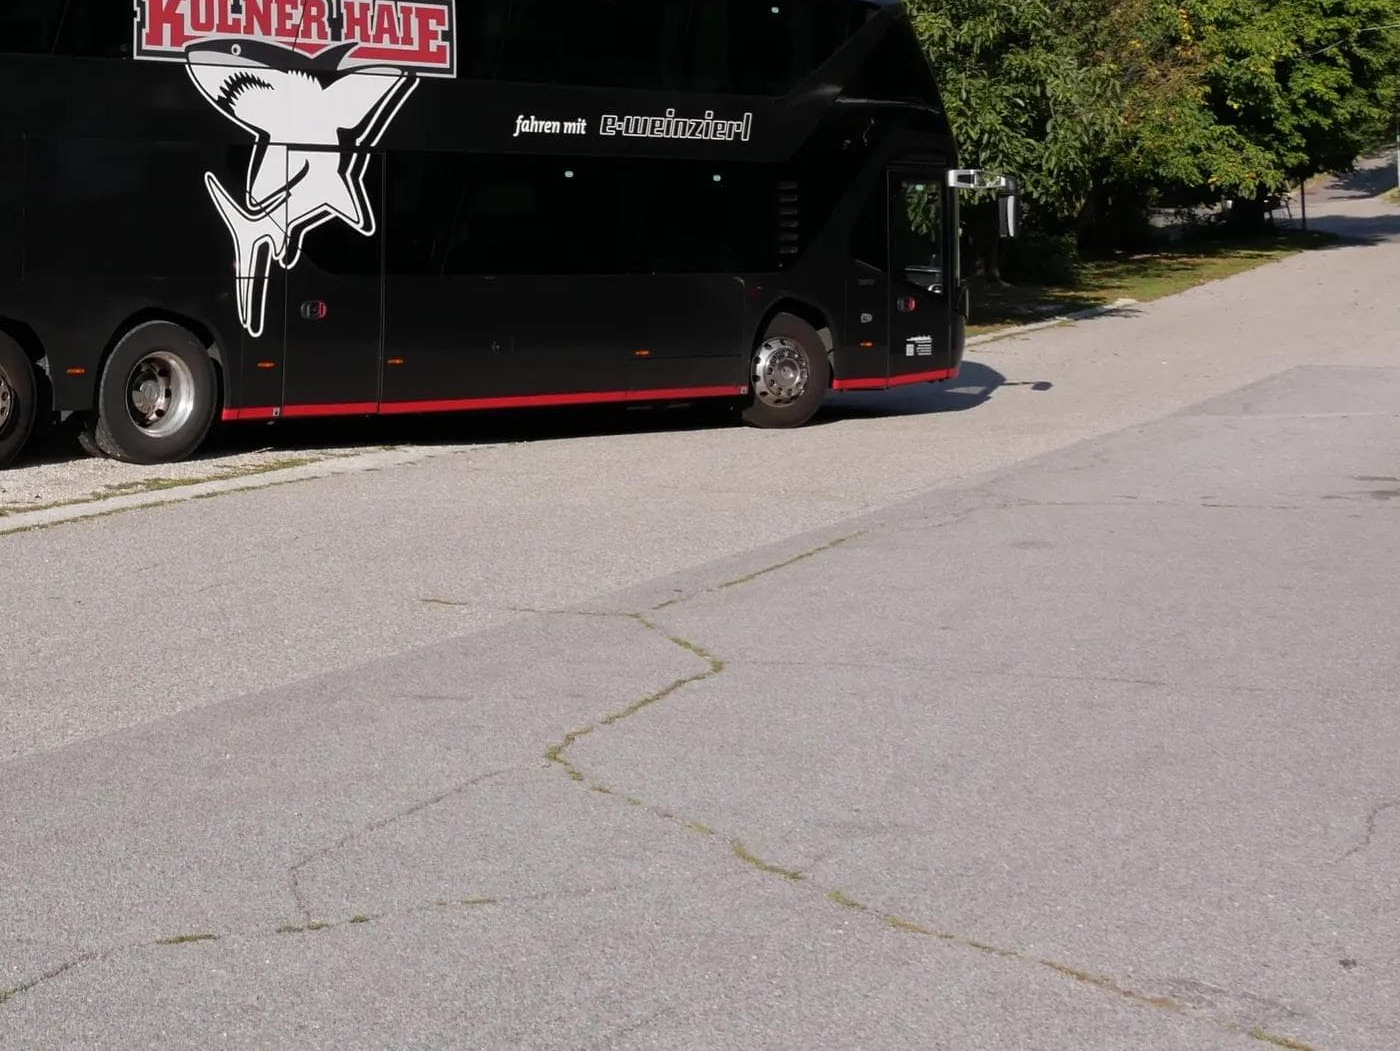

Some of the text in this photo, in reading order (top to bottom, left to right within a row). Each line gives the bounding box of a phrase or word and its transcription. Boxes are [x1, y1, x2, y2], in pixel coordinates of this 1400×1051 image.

[343, 0, 450, 64] HAIE
[512, 114, 561, 137] fahren
[563, 117, 587, 135] mit
